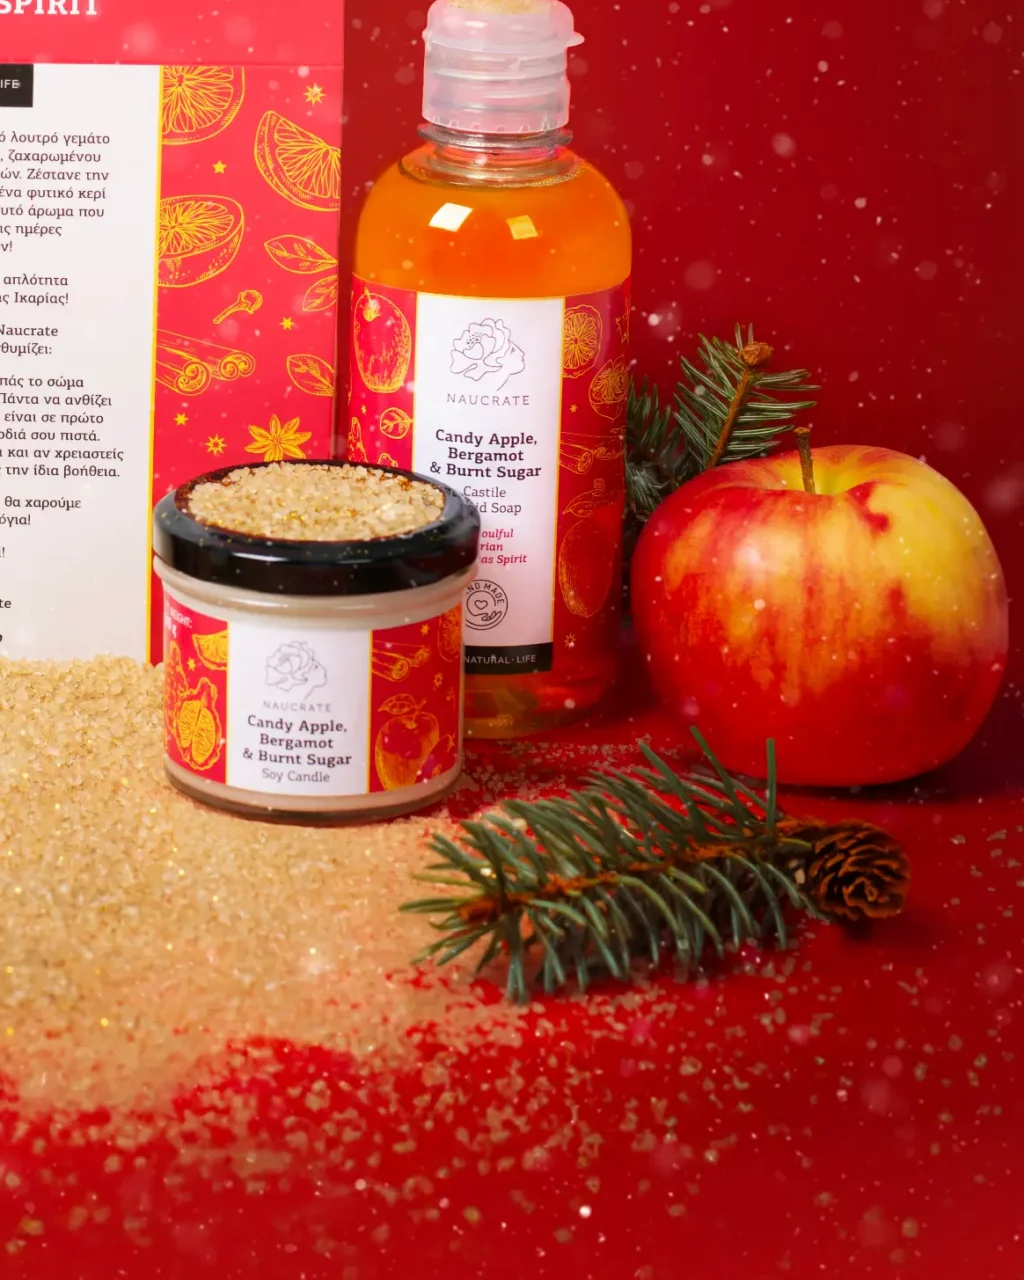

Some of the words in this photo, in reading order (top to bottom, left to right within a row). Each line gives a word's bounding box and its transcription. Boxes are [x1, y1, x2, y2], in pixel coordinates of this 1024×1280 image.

[10, 130, 59, 146] λουτρό
[63, 132, 110, 147] γεμάτο
[8, 148, 101, 165] ζαχαρωμένου
[26, 167, 81, 181] Ζέστανε
[85, 171, 110, 181] την
[14, 222, 63, 238] ημέρες
[3, 272, 69, 286] απλότητα
[27, 378, 43, 387] το
[46, 375, 84, 391] σώμα
[43, 396, 61, 406] να
[64, 393, 112, 408] ανθίζει
[446, 393, 530, 406] NAUCRATE
[435, 429, 483, 447] Candy
[489, 432, 537, 448] Apple,
[7, 448, 29, 458] και
[33, 449, 51, 459] αν
[54, 447, 124, 462] χρειαστείς
[448, 447, 524, 464] Bergamot
[430, 462, 441, 474] &
[446, 463, 491, 478] Burnt
[497, 465, 542, 480] Sugar
[463, 485, 506, 498] Castile
[4, 495, 21, 508] θα
[24, 496, 82, 512] χαρούμε
[491, 502, 521, 516] Soap
[481, 528, 514, 540] oulful
[496, 554, 527, 566] Spirit
[483, 583, 505, 604] MADE
[516, 654, 536, 664] LIFE
[262, 700, 333, 712] NAUCRATE
[247, 715, 293, 733] Candy
[298, 719, 348, 734] Apple,
[260, 733, 334, 749] Bergamot
[243, 748, 253, 760] &
[259, 750, 302, 765] Burnt
[307, 753, 352, 768] Sugar
[262, 768, 283, 782] Soy
[287, 770, 330, 783] Candle
